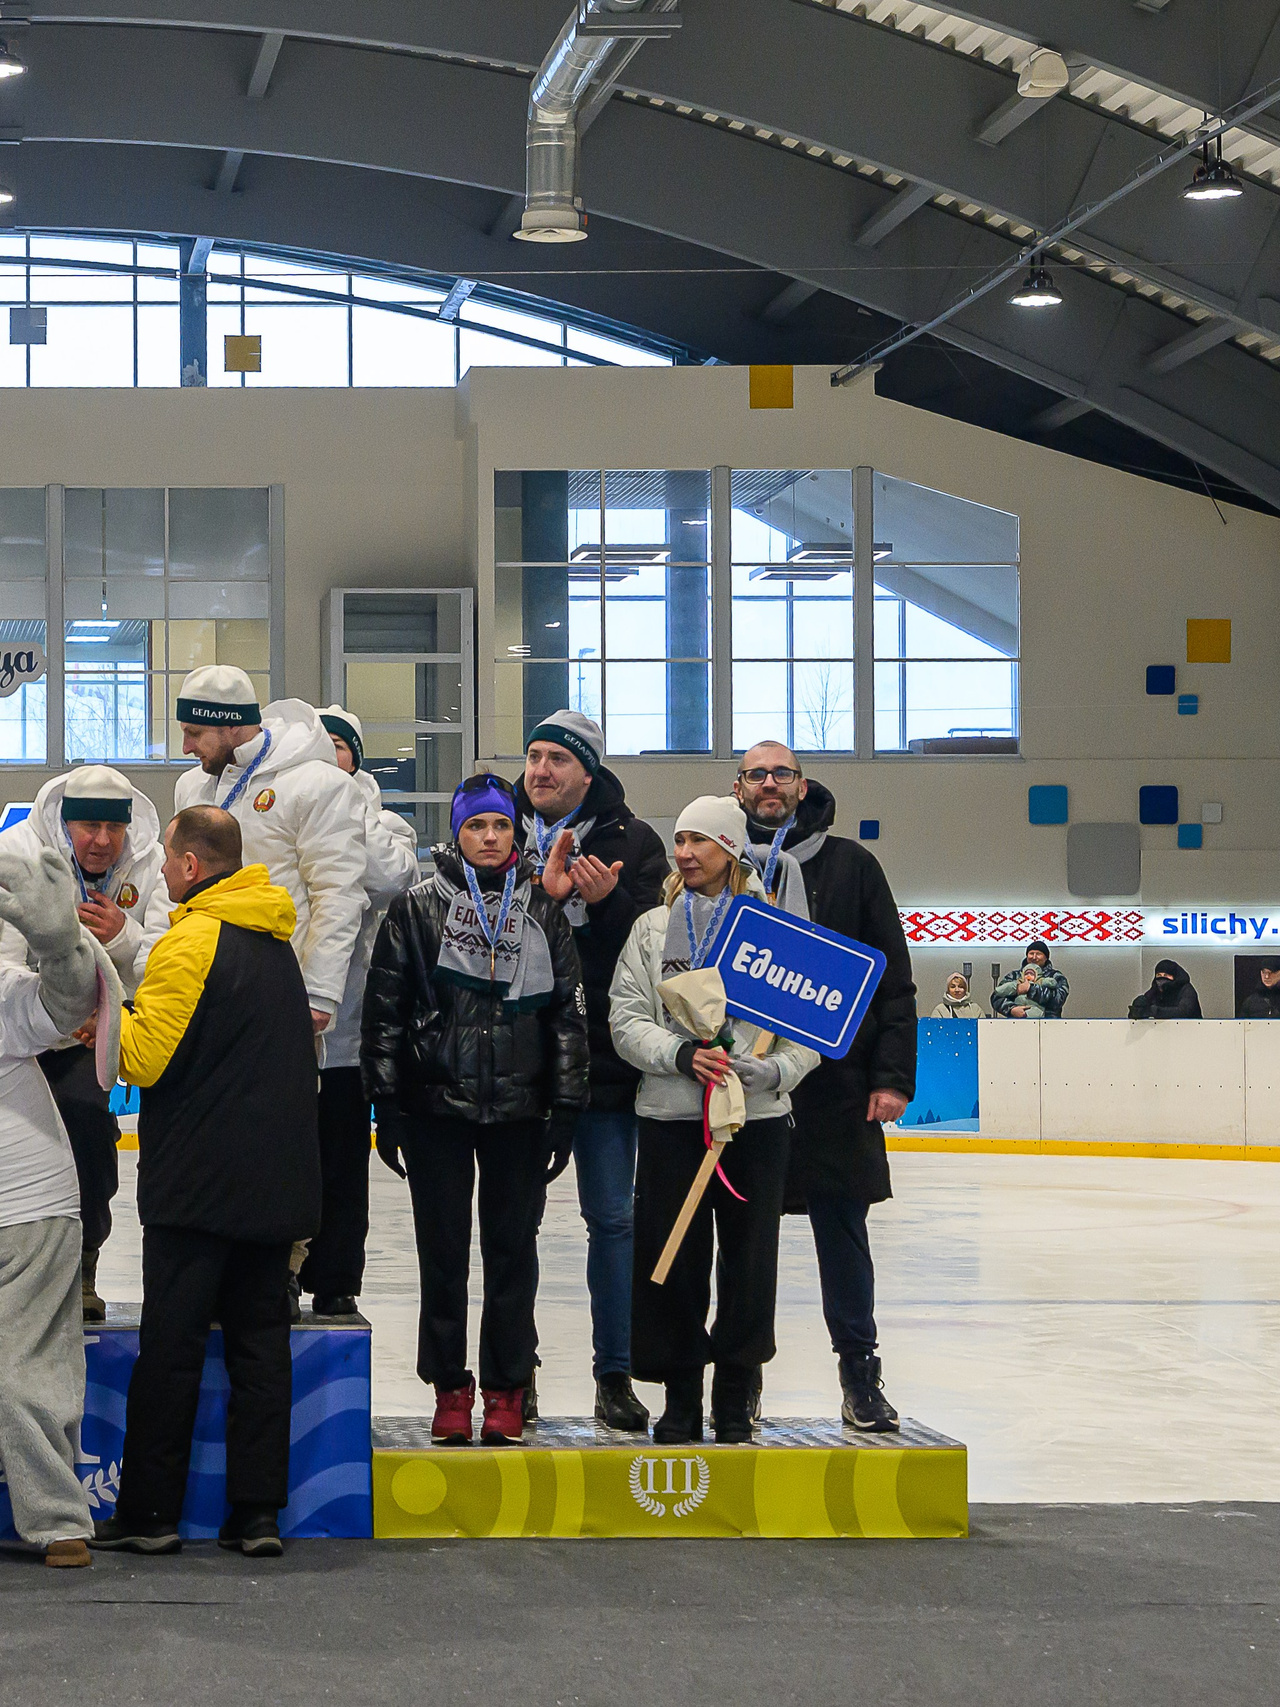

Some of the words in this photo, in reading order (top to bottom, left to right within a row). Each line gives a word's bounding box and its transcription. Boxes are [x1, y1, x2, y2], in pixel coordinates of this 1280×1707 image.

[192, 707, 242, 720] БЕЛАРУСЬ
[731, 941, 843, 1012] Единые
[642, 1458, 697, 1494] III
